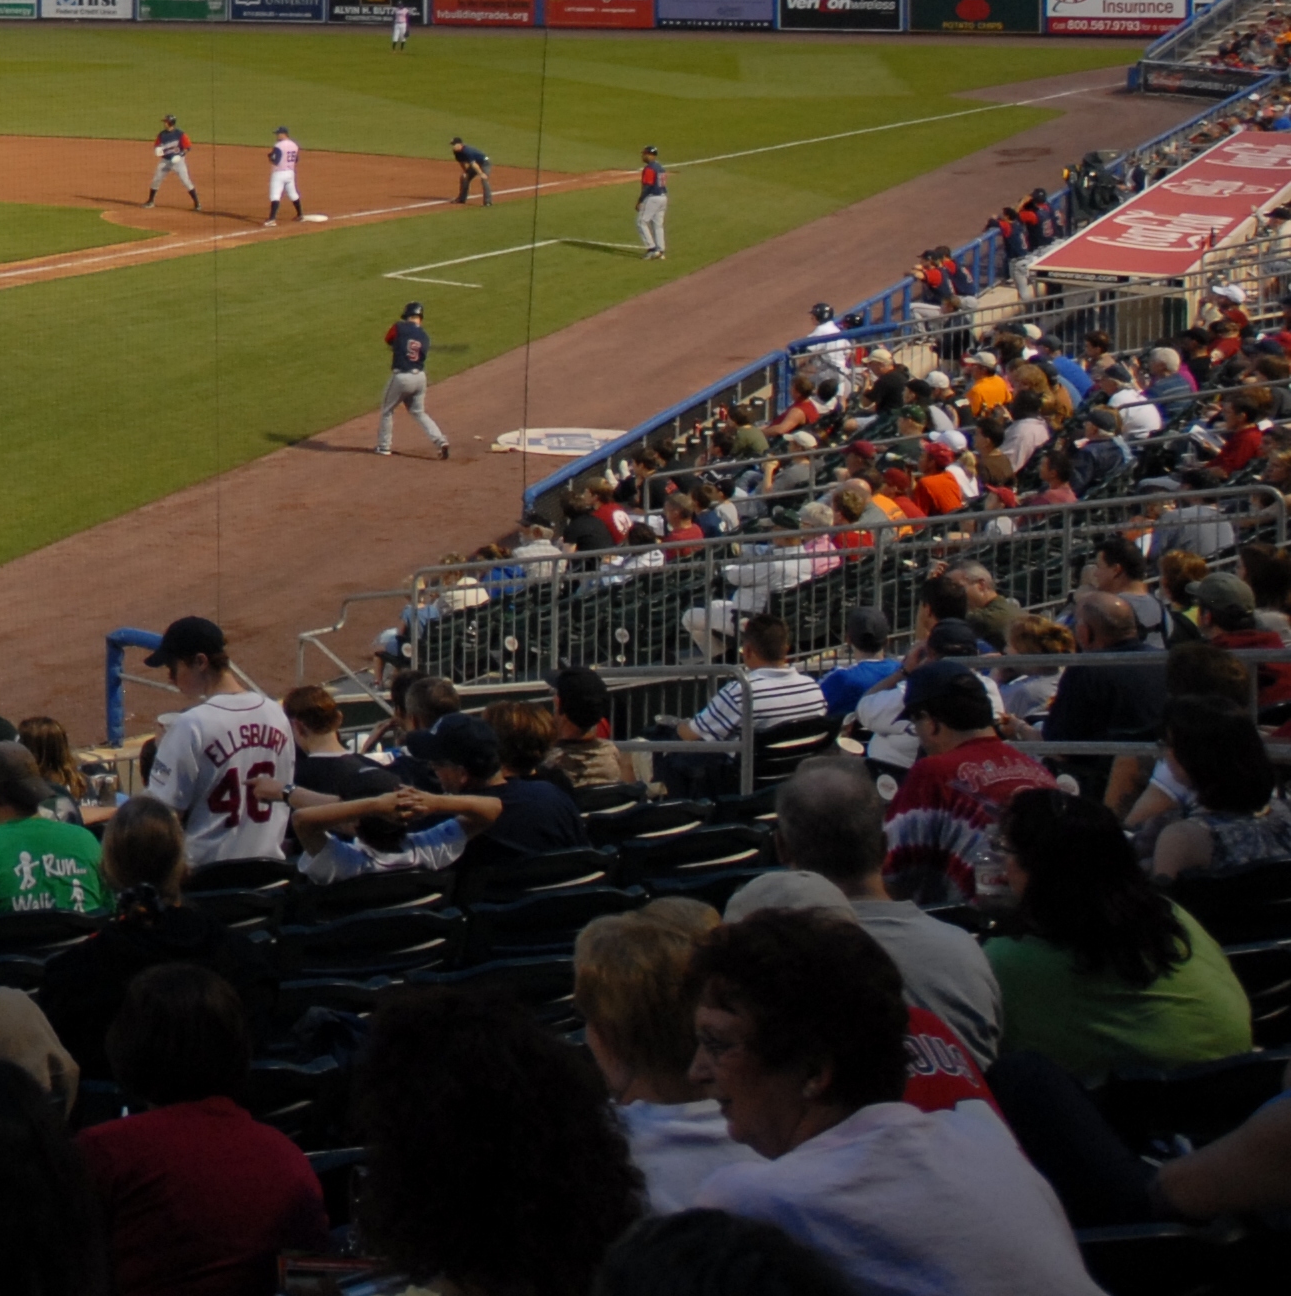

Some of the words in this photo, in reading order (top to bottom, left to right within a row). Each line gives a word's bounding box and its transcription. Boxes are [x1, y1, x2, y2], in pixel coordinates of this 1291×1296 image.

[437, 10, 529, 22] lvbuildingtrades.org
[1103, 0, 1174, 14] Insurance
[406, 339, 421, 362] 5
[204, 723, 288, 768] ELLSBURY
[208, 761, 276, 828] 46
[42, 853, 87, 877] Run...
